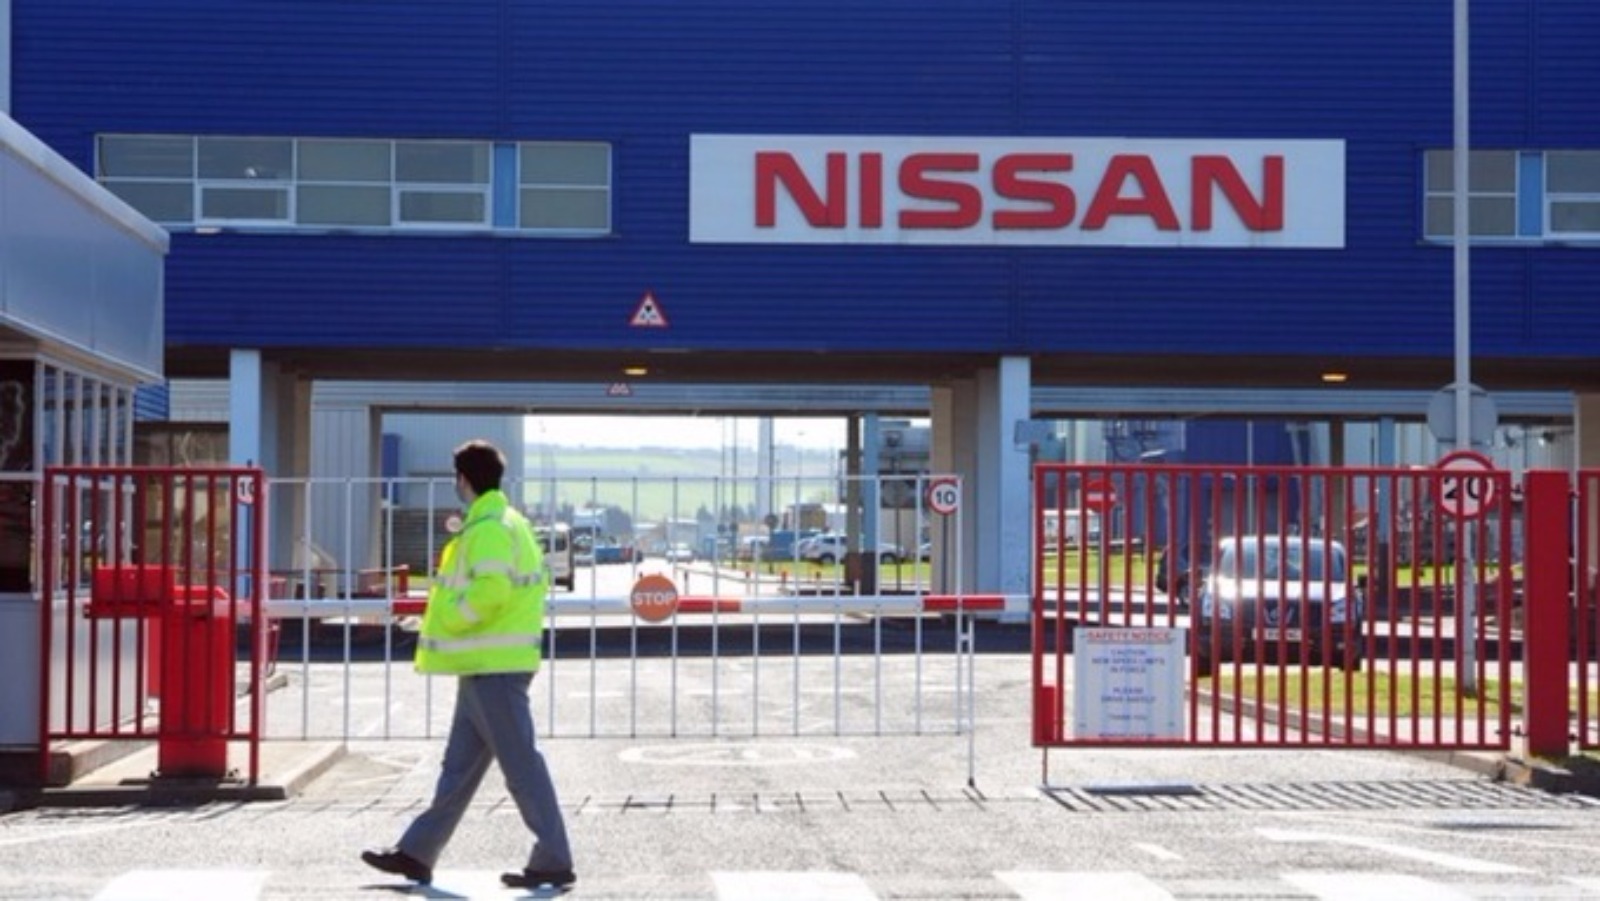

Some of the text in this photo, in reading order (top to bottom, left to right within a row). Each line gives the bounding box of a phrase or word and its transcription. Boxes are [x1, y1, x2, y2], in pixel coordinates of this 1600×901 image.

[754, 151, 1284, 232] NISSAN
[936, 490, 956, 505] 10
[634, 591, 676, 606] STOP
[1087, 631, 1170, 640] SAFETY NOTICE
